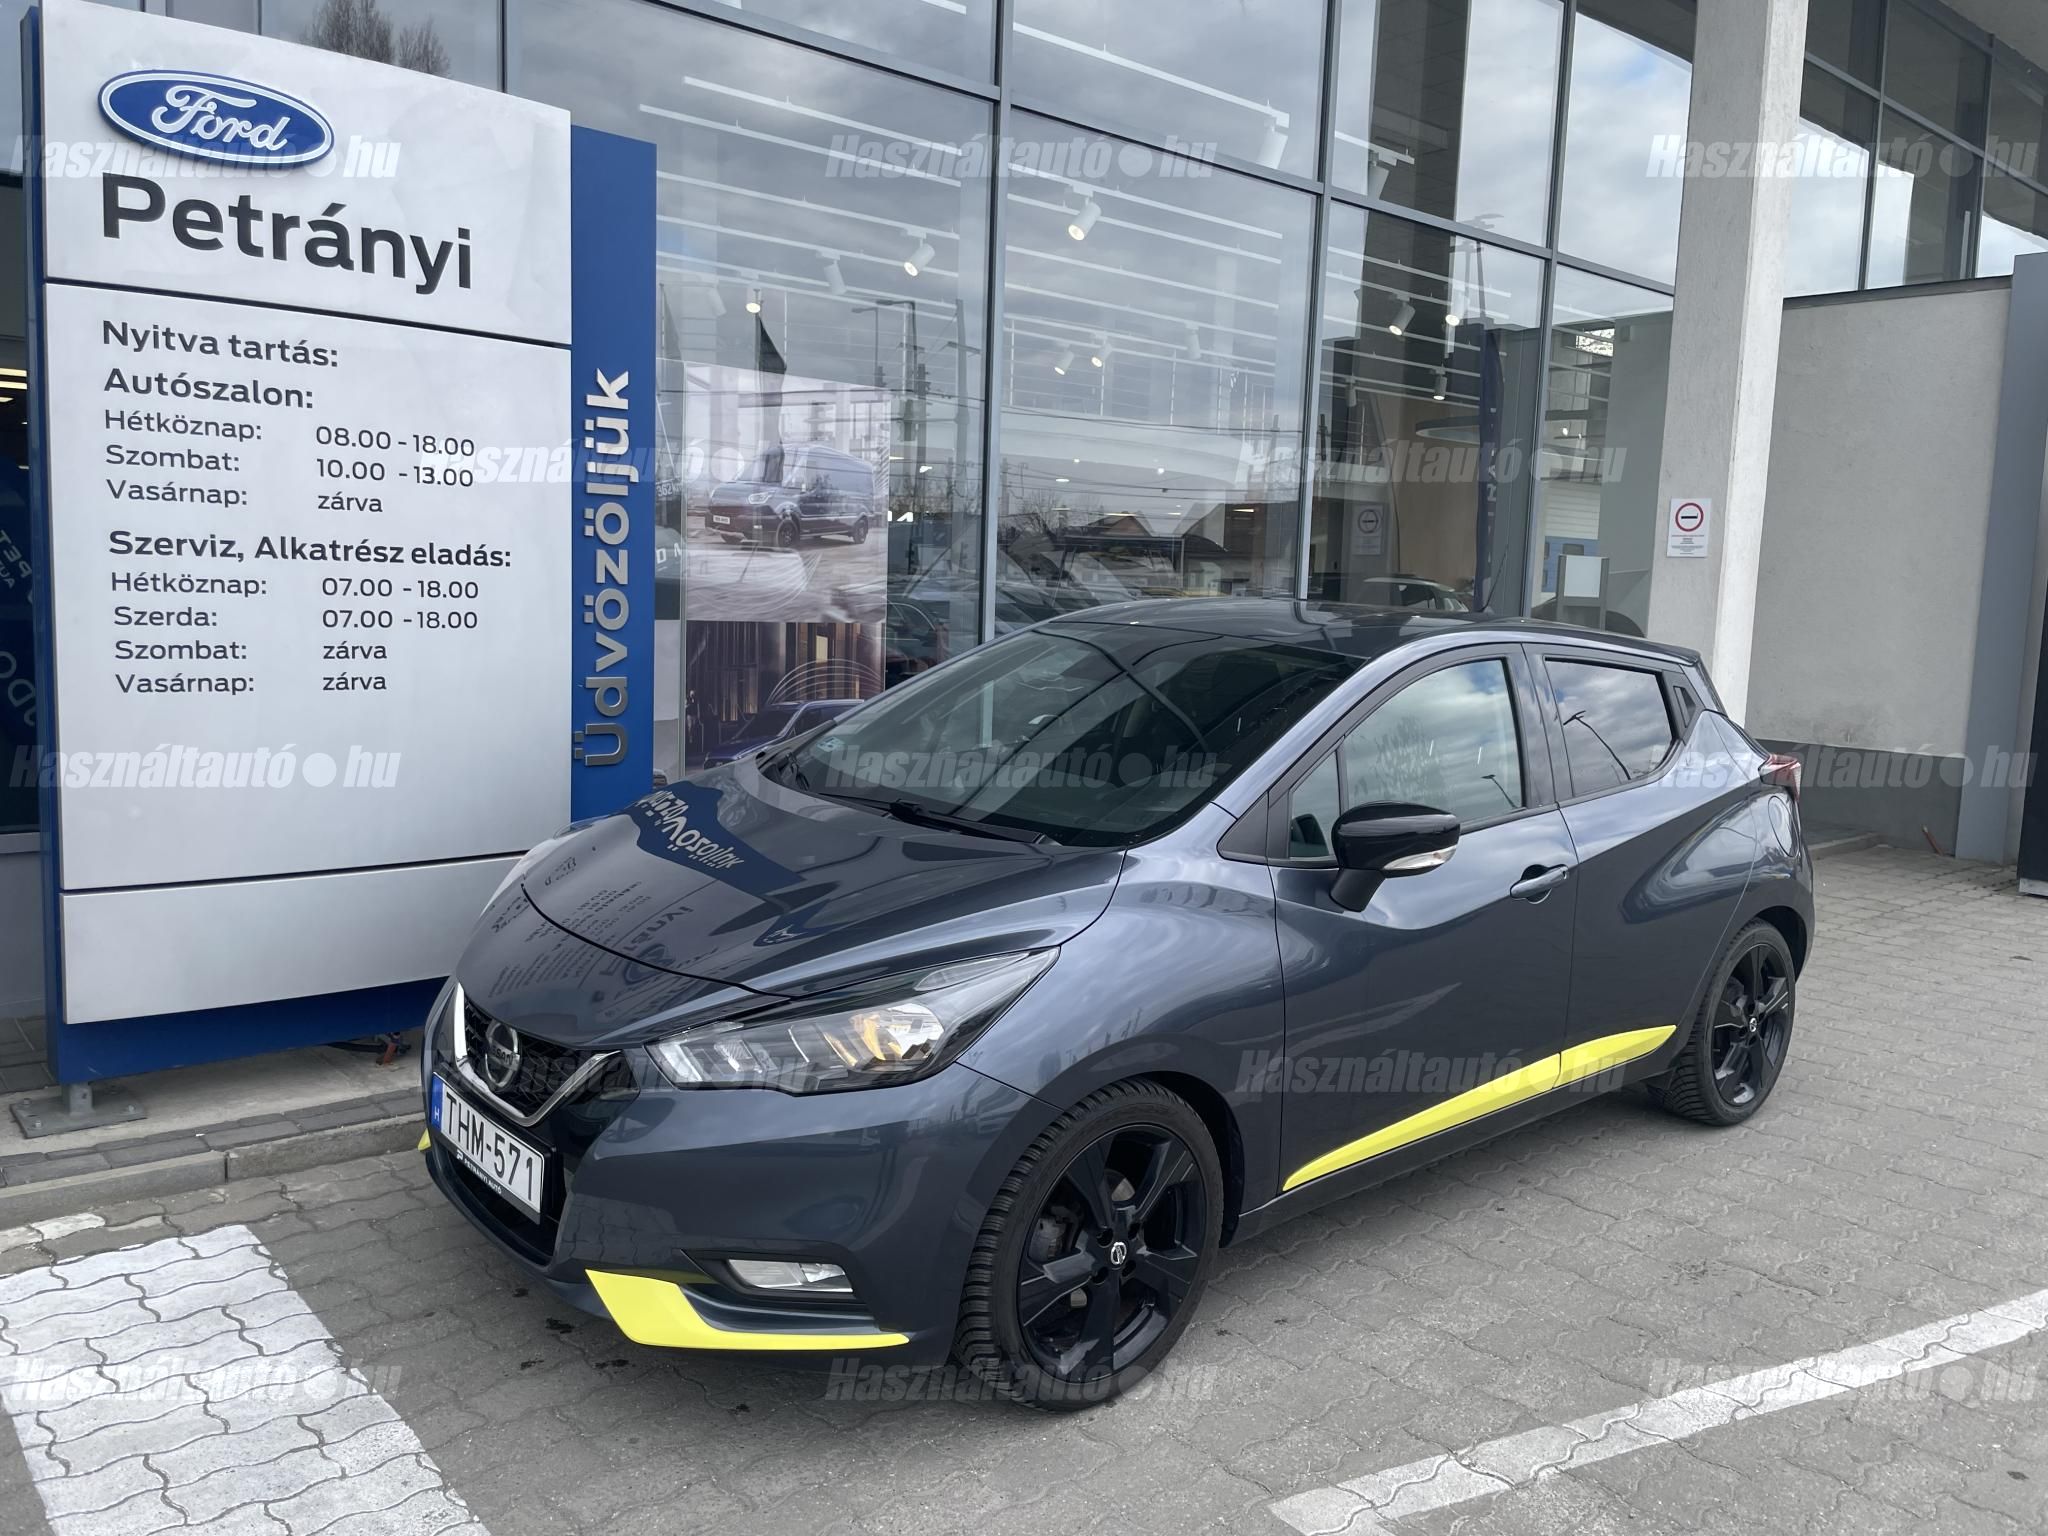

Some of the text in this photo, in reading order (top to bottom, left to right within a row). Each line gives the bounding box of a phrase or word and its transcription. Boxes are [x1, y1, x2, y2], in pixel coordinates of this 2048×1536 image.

[152, 84, 291, 151] Ford
[102, 172, 472, 295] Petrányi
[103, 320, 338, 367] Nyitva tartás:
[103, 368, 315, 409] Autószalon:
[105, 409, 263, 441] Hétköznap:
[316, 426, 391, 450] 08.00
[412, 434, 475, 457] 18.00
[105, 444, 240, 472] Szombat:
[316, 458, 385, 481] 10.00
[413, 464, 474, 487] 13.00
[106, 479, 384, 513] Vasárnap: zárva
[109, 530, 512, 568] Szerviz, Alkatrész eladás:
[574, 368, 640, 766] Üdvözöljük
[111, 571, 268, 598] Hétköznap:
[322, 577, 393, 598] 07.00
[417, 580, 480, 600] 18.00
[113, 606, 218, 627] Szerda:
[322, 609, 393, 629] 07.00
[416, 611, 479, 630] 18.00
[115, 639, 388, 661] Szombat: zárva
[115, 671, 388, 697] Vasárnap: zárva
[446, 1091, 534, 1202] THM-571
